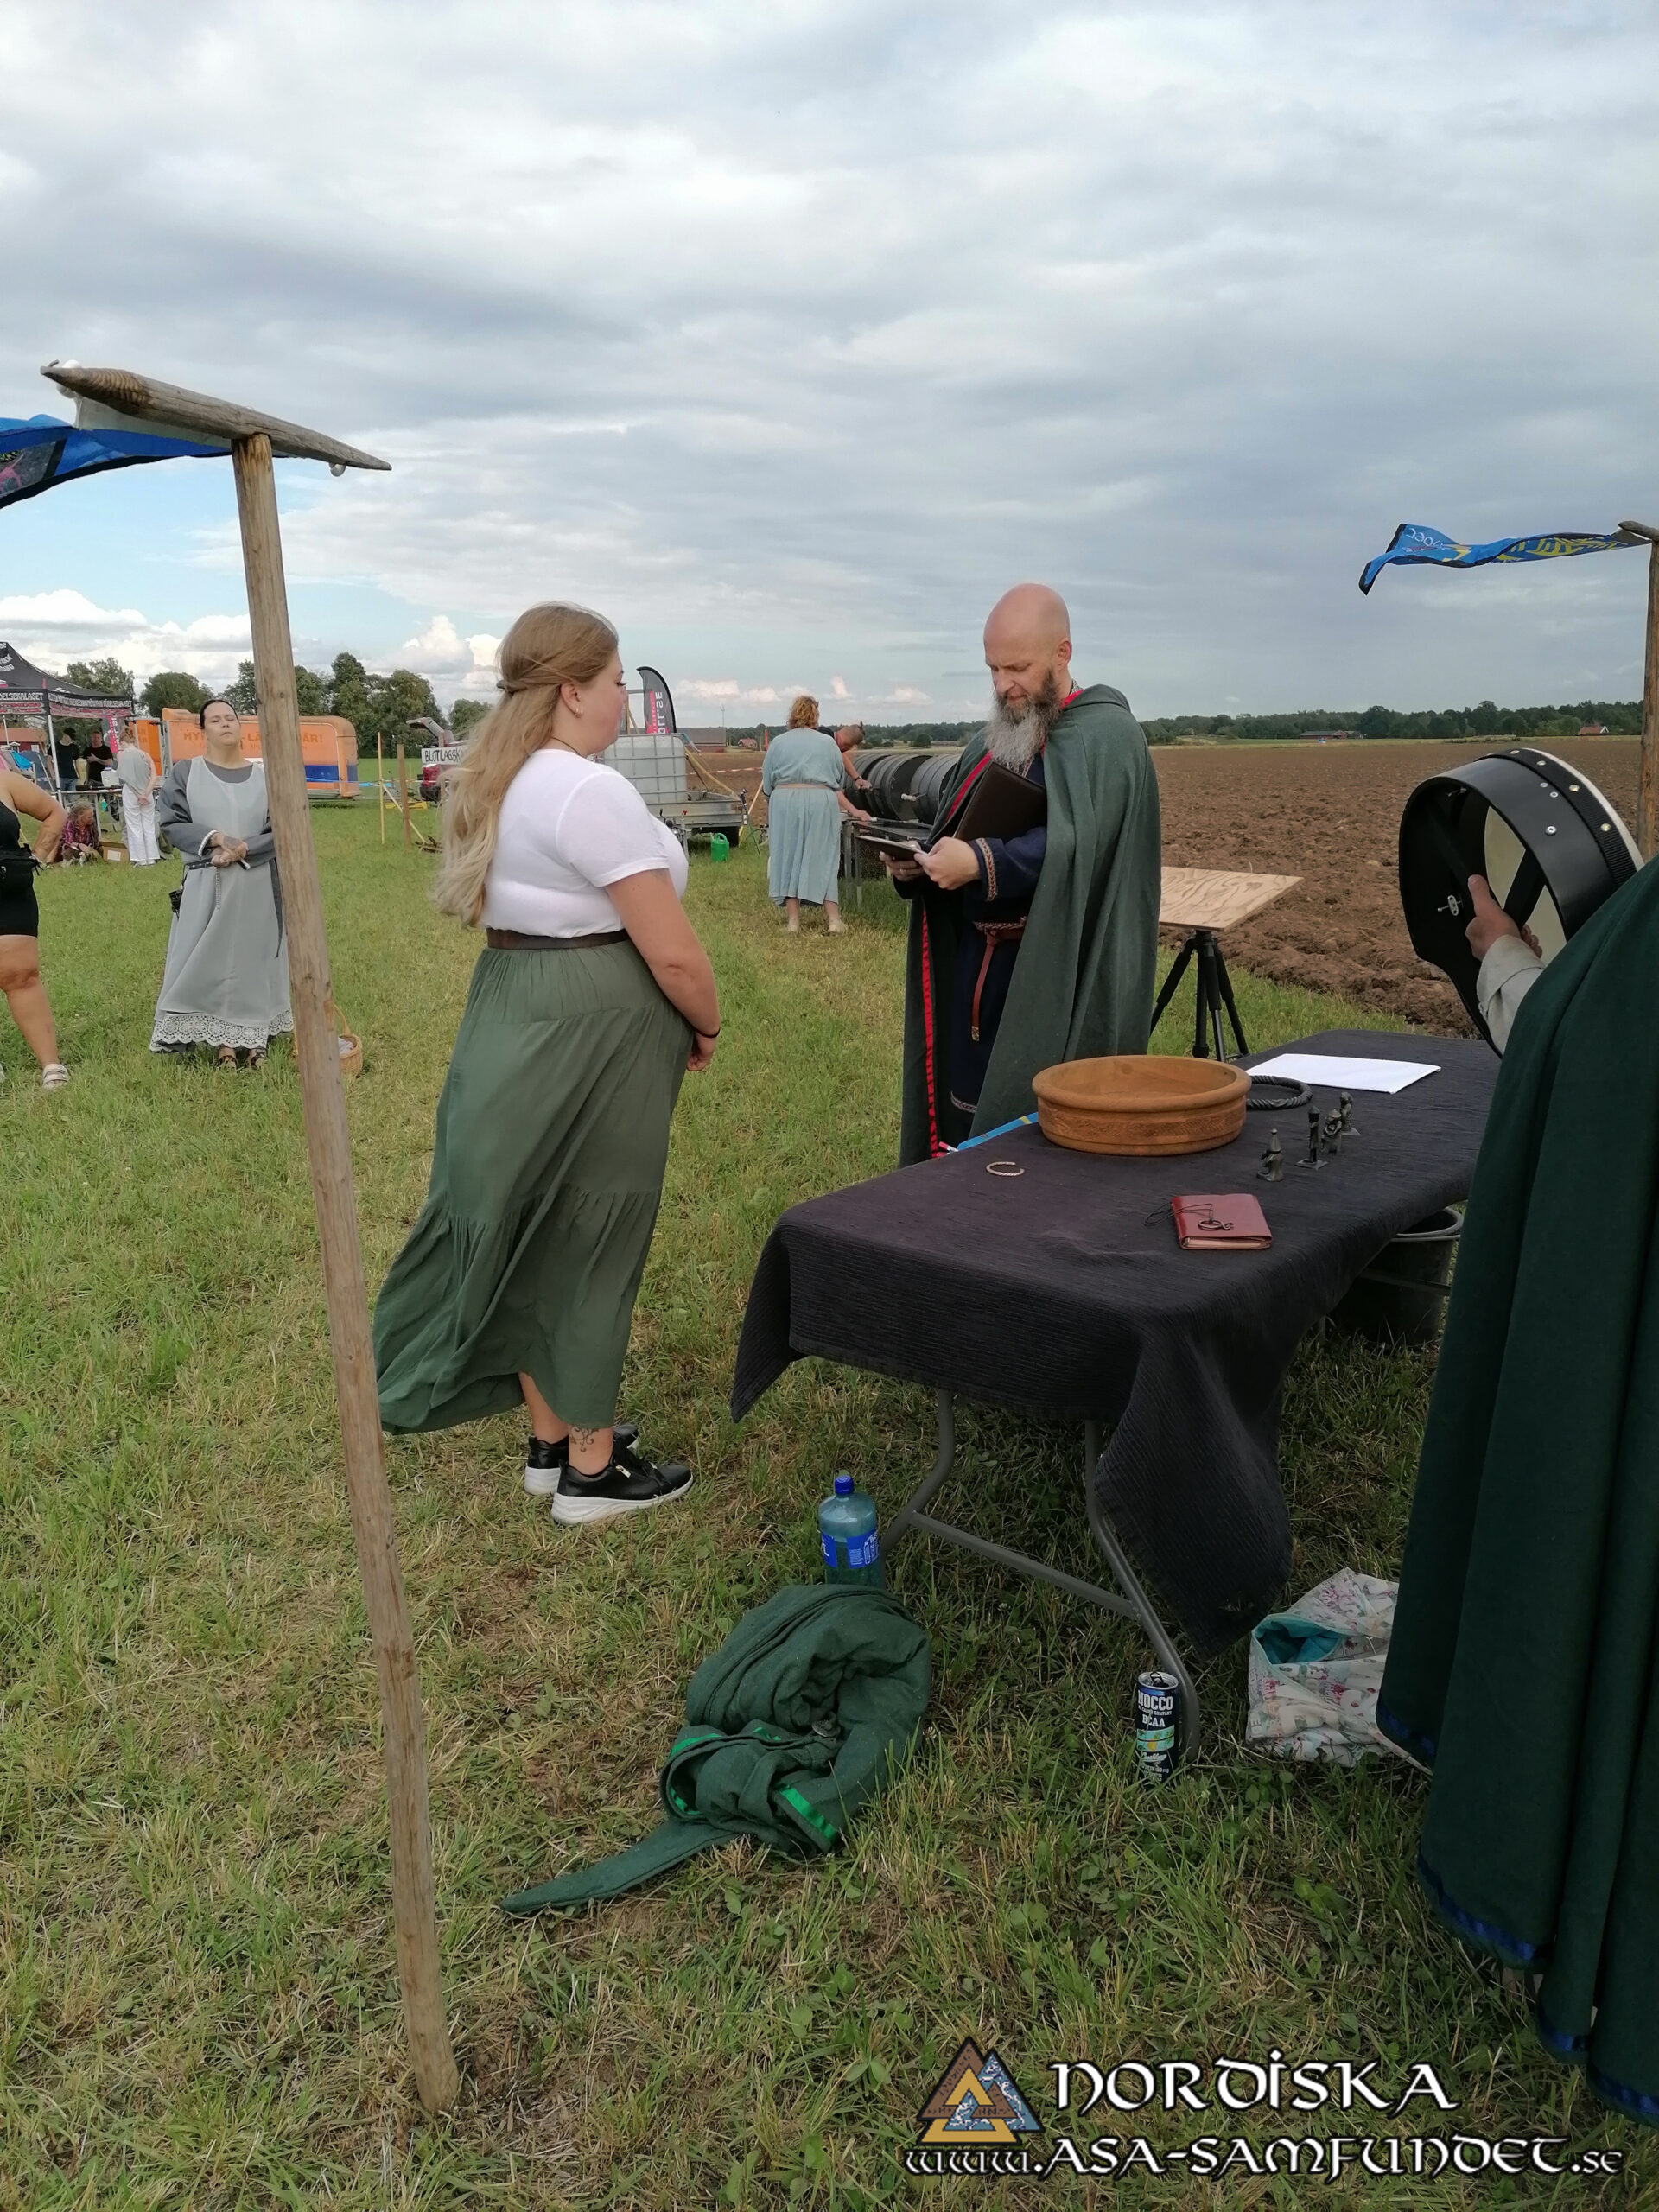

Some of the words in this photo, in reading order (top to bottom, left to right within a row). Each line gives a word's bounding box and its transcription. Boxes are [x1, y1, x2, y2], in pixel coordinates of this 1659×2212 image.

[299, 732, 323, 743] ÄR!
[1137, 1689, 1173, 1711] NOCCO
[1141, 1713, 1166, 1727] BCAA
